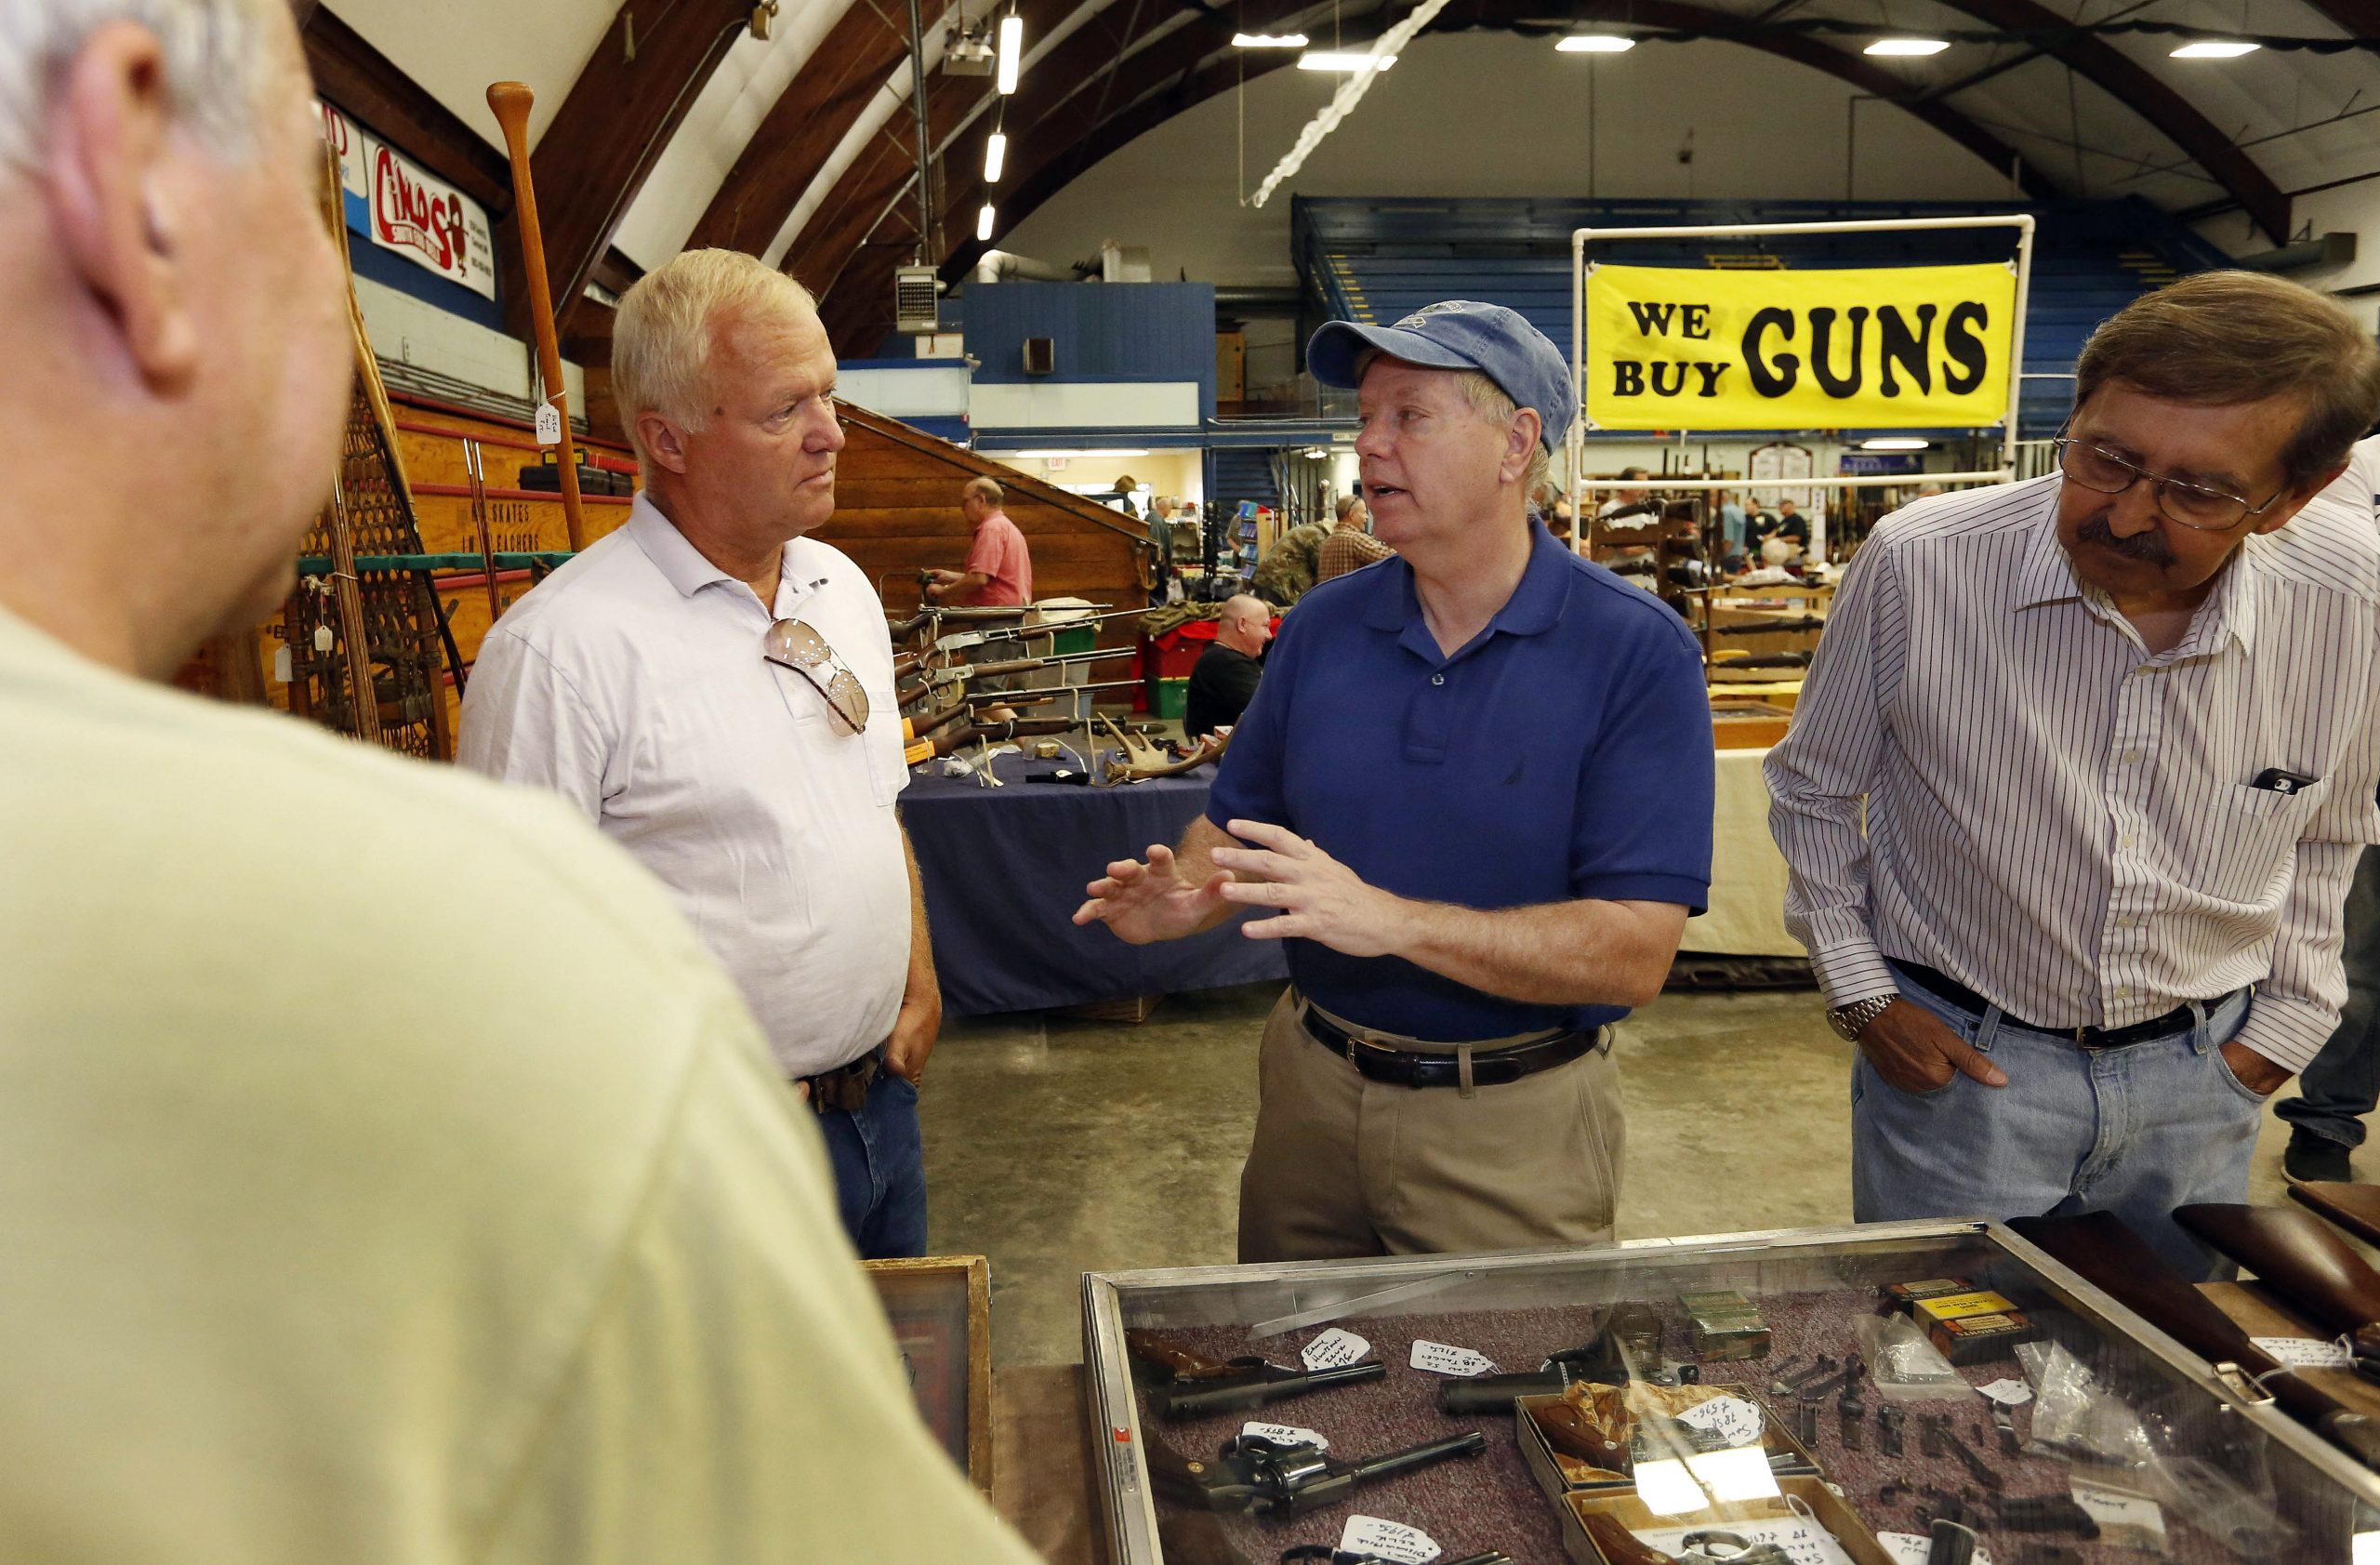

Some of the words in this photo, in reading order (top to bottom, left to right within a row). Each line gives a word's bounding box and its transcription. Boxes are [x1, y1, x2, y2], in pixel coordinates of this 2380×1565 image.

[1628, 300, 1711, 340] WE
[1742, 300, 1988, 398] GUNS
[1613, 360, 1731, 397] BUY
[493, 503, 529, 523] SKATES
